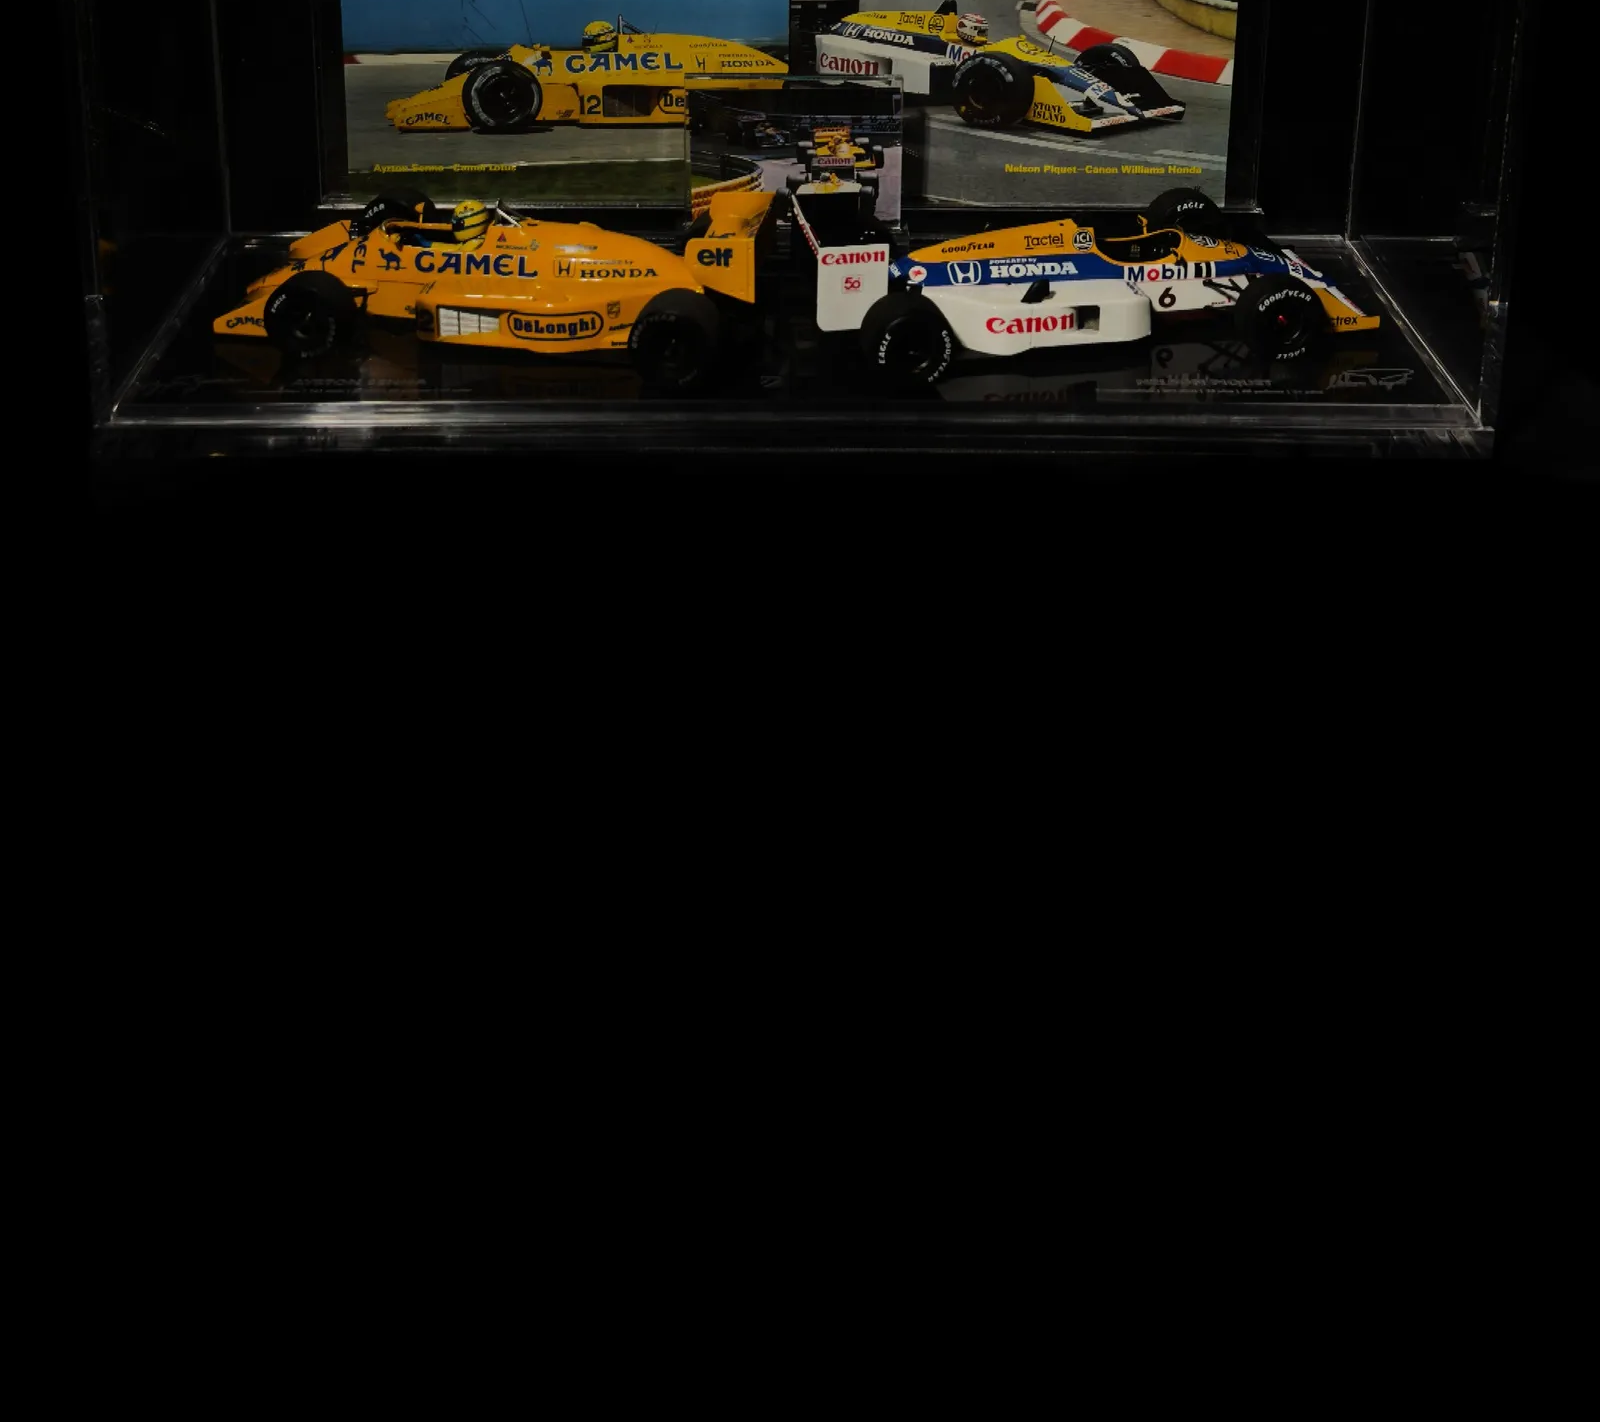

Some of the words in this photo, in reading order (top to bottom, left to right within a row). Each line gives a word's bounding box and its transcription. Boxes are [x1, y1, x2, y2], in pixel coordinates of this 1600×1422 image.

[897, 11, 926, 26] Tactel
[862, 28, 915, 46] HONDA
[565, 52, 684, 74] CAMEL
[720, 60, 775, 69] HONDA
[820, 51, 879, 76] Canon
[580, 94, 601, 116] 12
[1033, 101, 1064, 115] STONE
[405, 112, 451, 126] CAMEL
[1031, 109, 1066, 124] ISLAND
[1004, 163, 1041, 174] Nelson
[1121, 164, 1165, 175] Williams
[1167, 165, 1202, 175] Honda
[1176, 201, 1205, 213] EAGLE
[941, 241, 995, 254] GOODYEAR
[1023, 232, 1064, 249] Tactel
[414, 250, 538, 278] CAMEL
[697, 247, 733, 267] elf
[821, 250, 885, 265] Canon
[579, 268, 659, 278] HONDA
[990, 261, 1079, 278] HONDA
[1127, 263, 1187, 282] Mobil
[1158, 285, 1177, 308] 6
[1258, 289, 1312, 312] GOODYEAR
[226, 316, 265, 328] CAME
[513, 316, 597, 336] DeLonghi
[985, 313, 1074, 334] Canon
[878, 332, 891, 364] EAGLE
